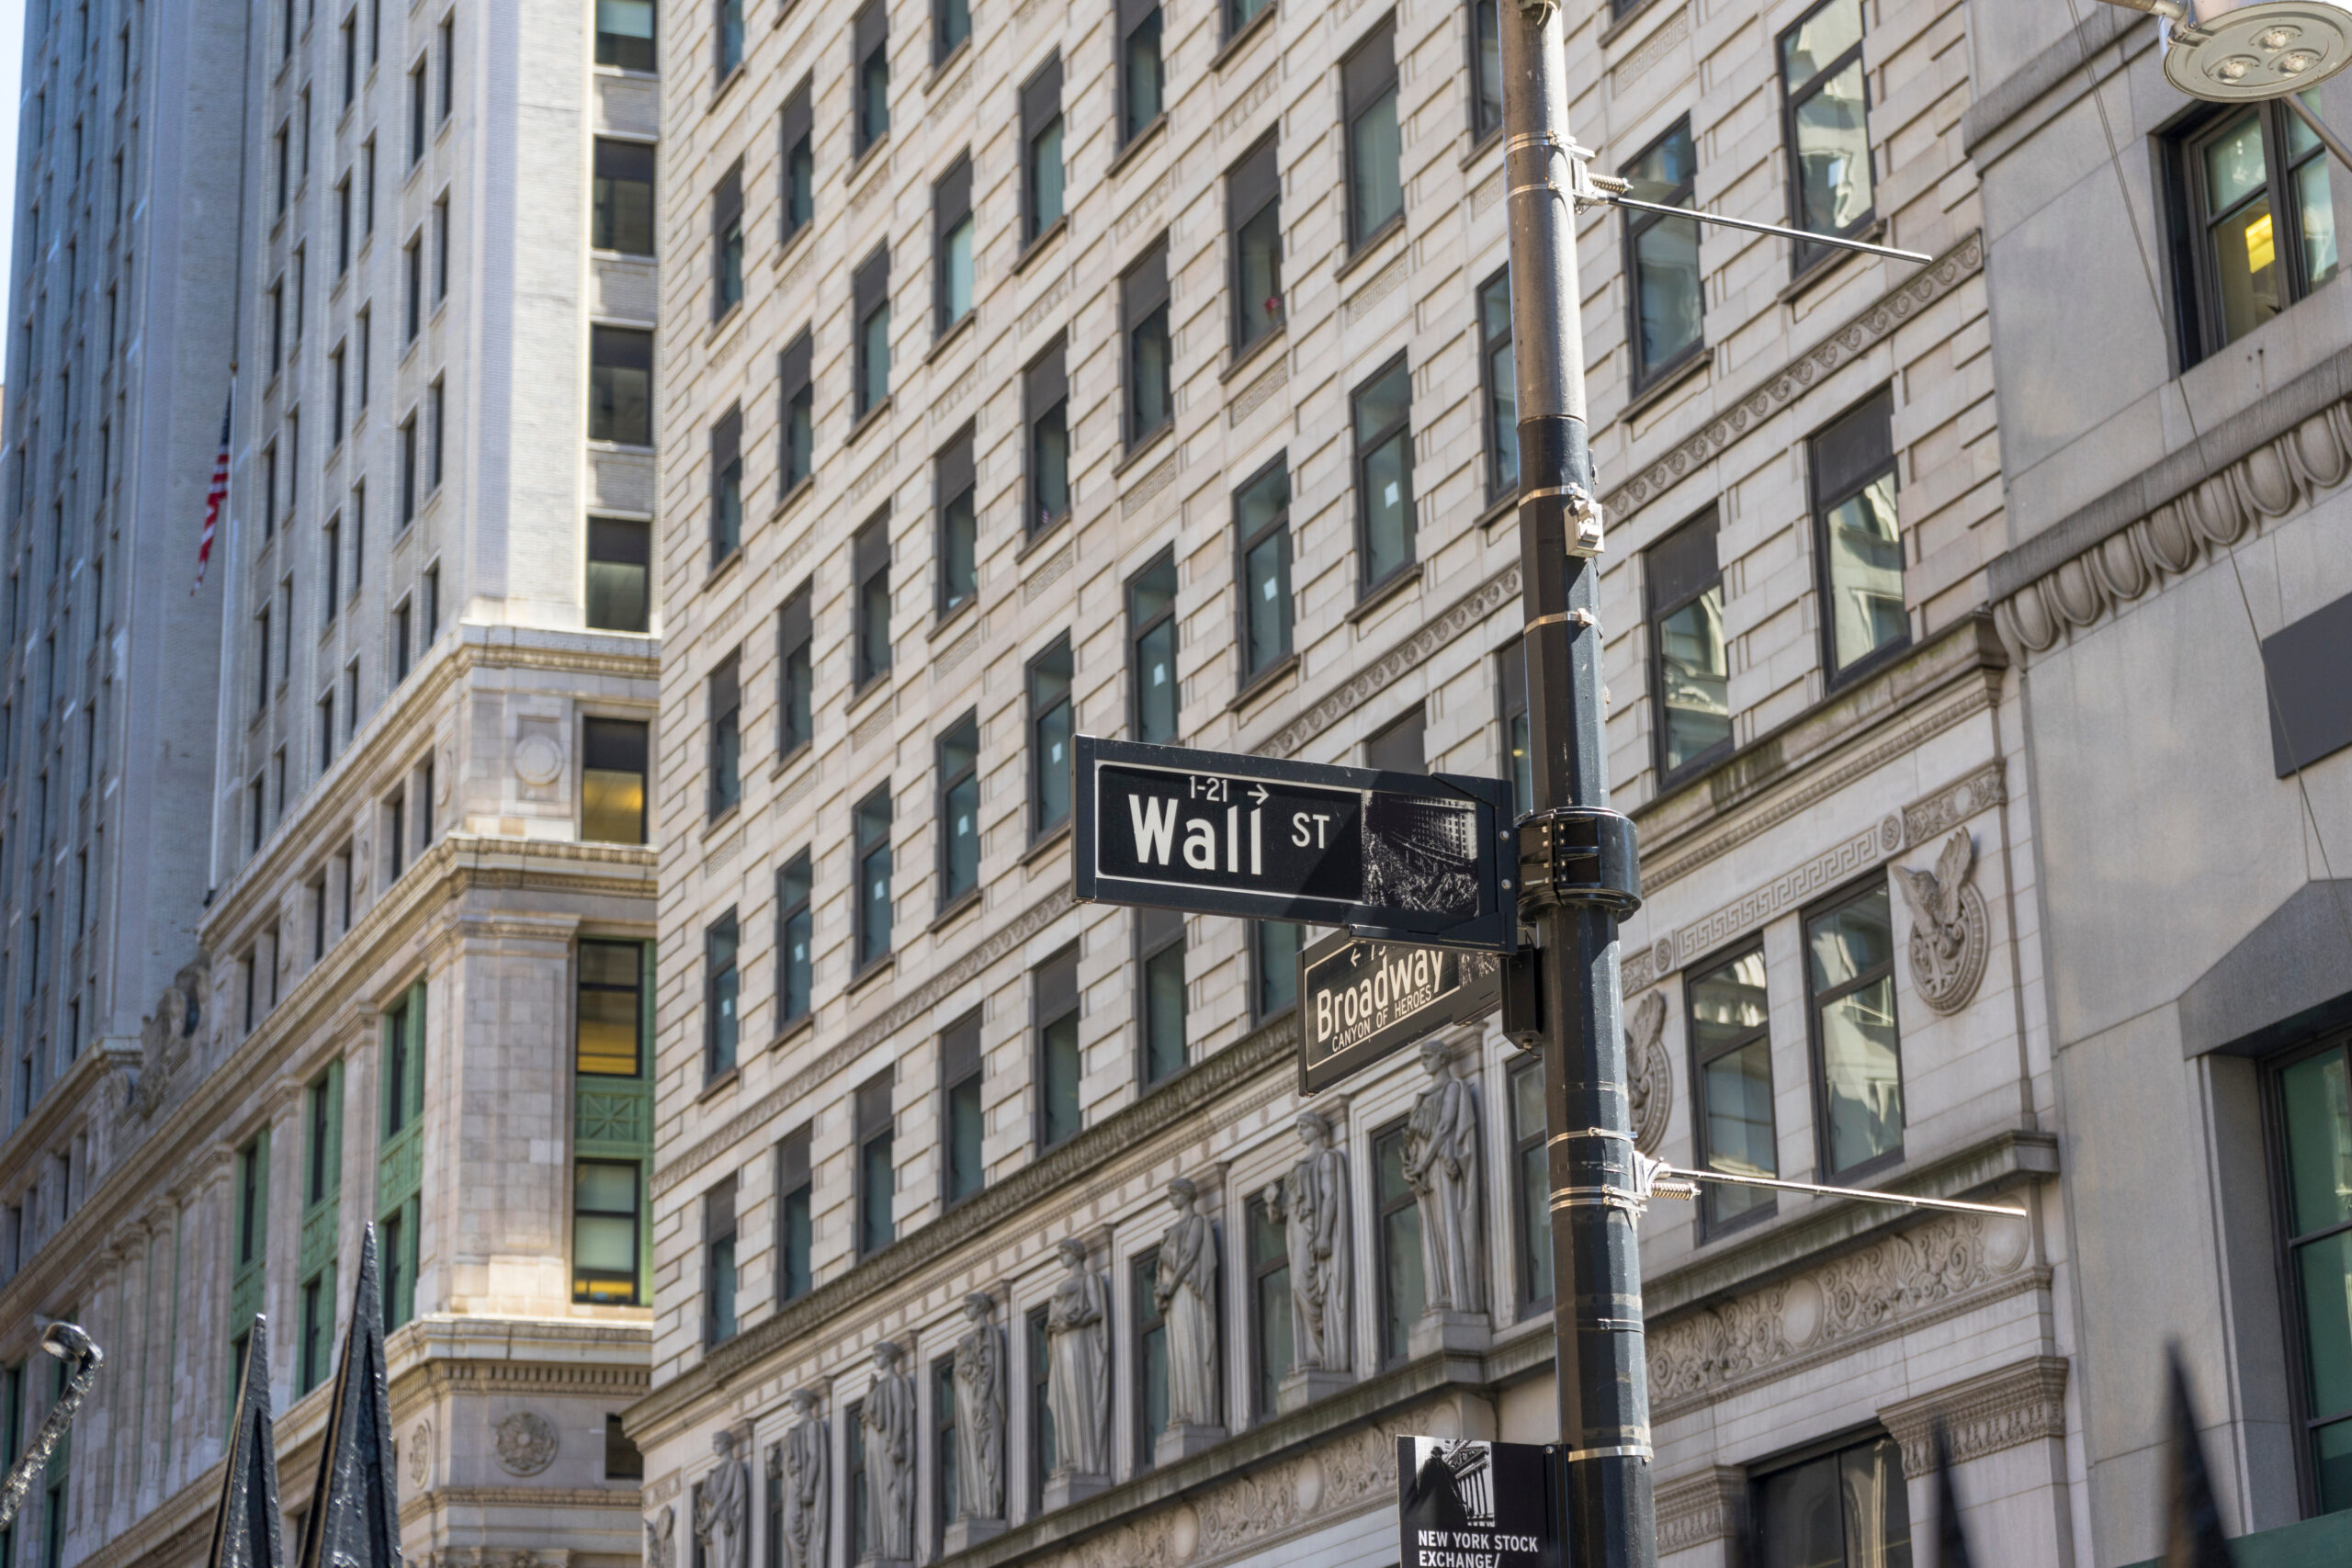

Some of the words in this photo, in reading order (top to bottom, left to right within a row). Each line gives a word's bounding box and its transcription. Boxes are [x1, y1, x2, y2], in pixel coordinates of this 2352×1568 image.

[1189, 775, 1228, 803] 1-21
[1128, 794, 1262, 875] Wall
[1291, 812, 1330, 850] ST
[1317, 949, 1443, 1043] Broadway
[1331, 1021, 1371, 1053] CANYON
[1375, 1007, 1389, 1029] OF
[1395, 984, 1431, 1019] HEROES
[1418, 1529, 1448, 1547] NEW
[1453, 1531, 1490, 1550] YORK
[1494, 1535, 1539, 1552] STOCK
